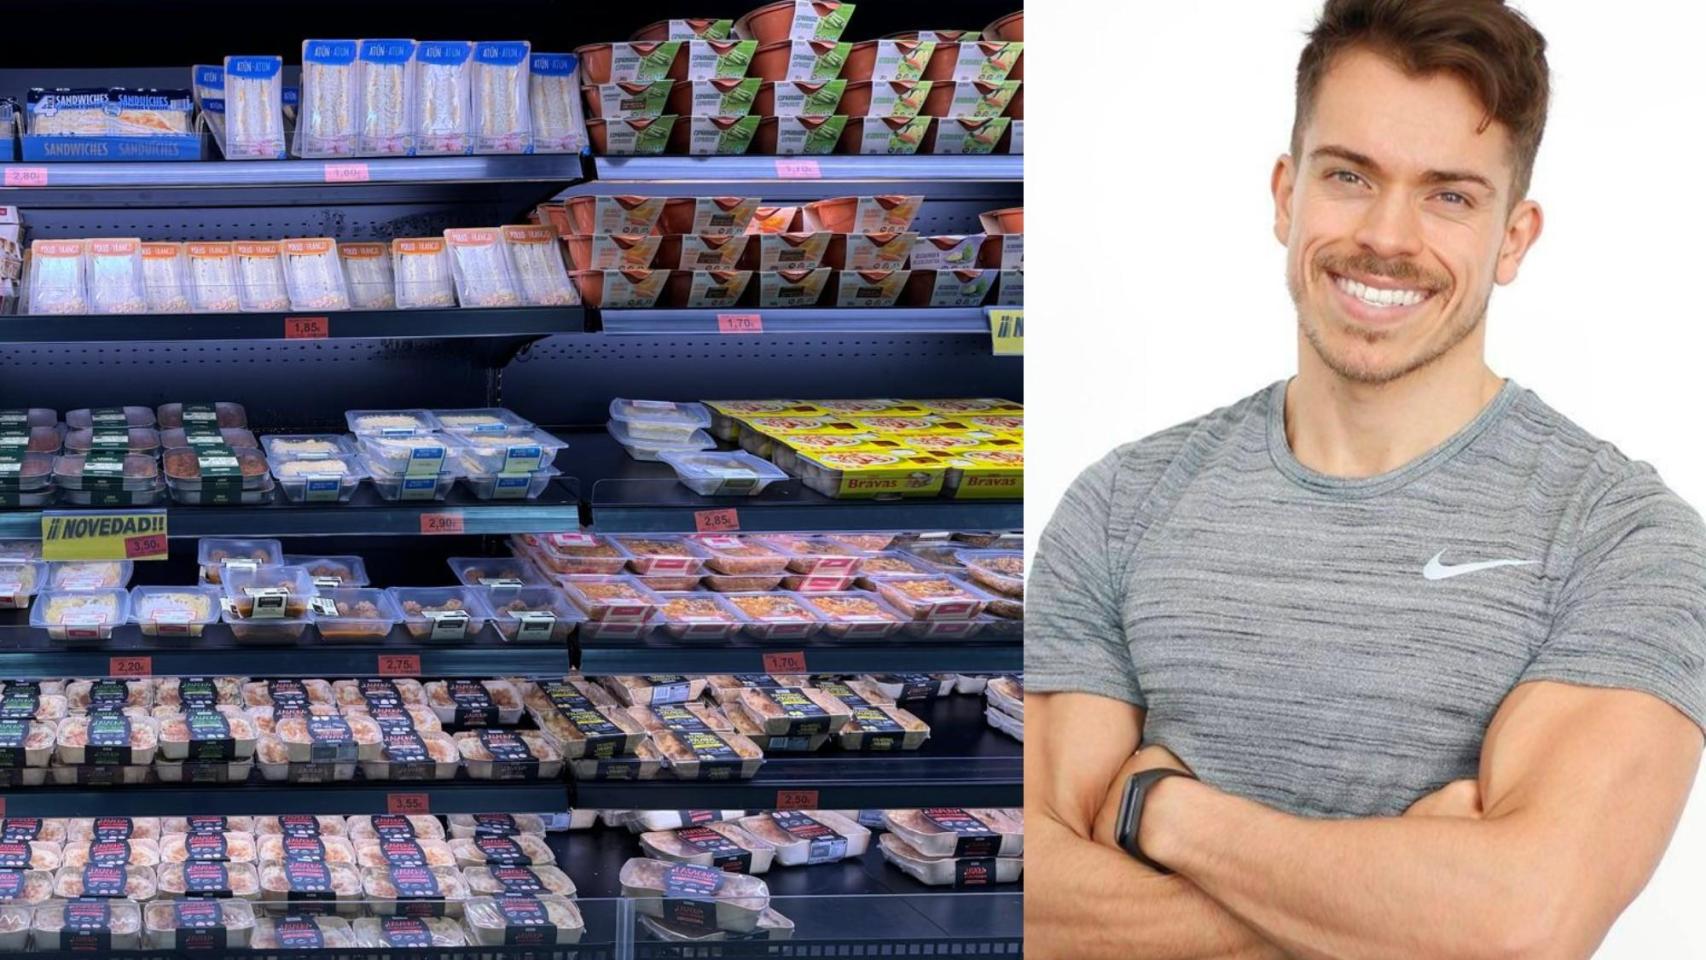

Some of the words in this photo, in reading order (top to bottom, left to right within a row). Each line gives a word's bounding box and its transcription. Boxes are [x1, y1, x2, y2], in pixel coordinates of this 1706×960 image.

[56, 93, 109, 105] SANDWICHES
[44, 143, 109, 156] SANDWICHES
[848, 478, 897, 489] Bravas
[968, 477, 1016, 487] Bravas
